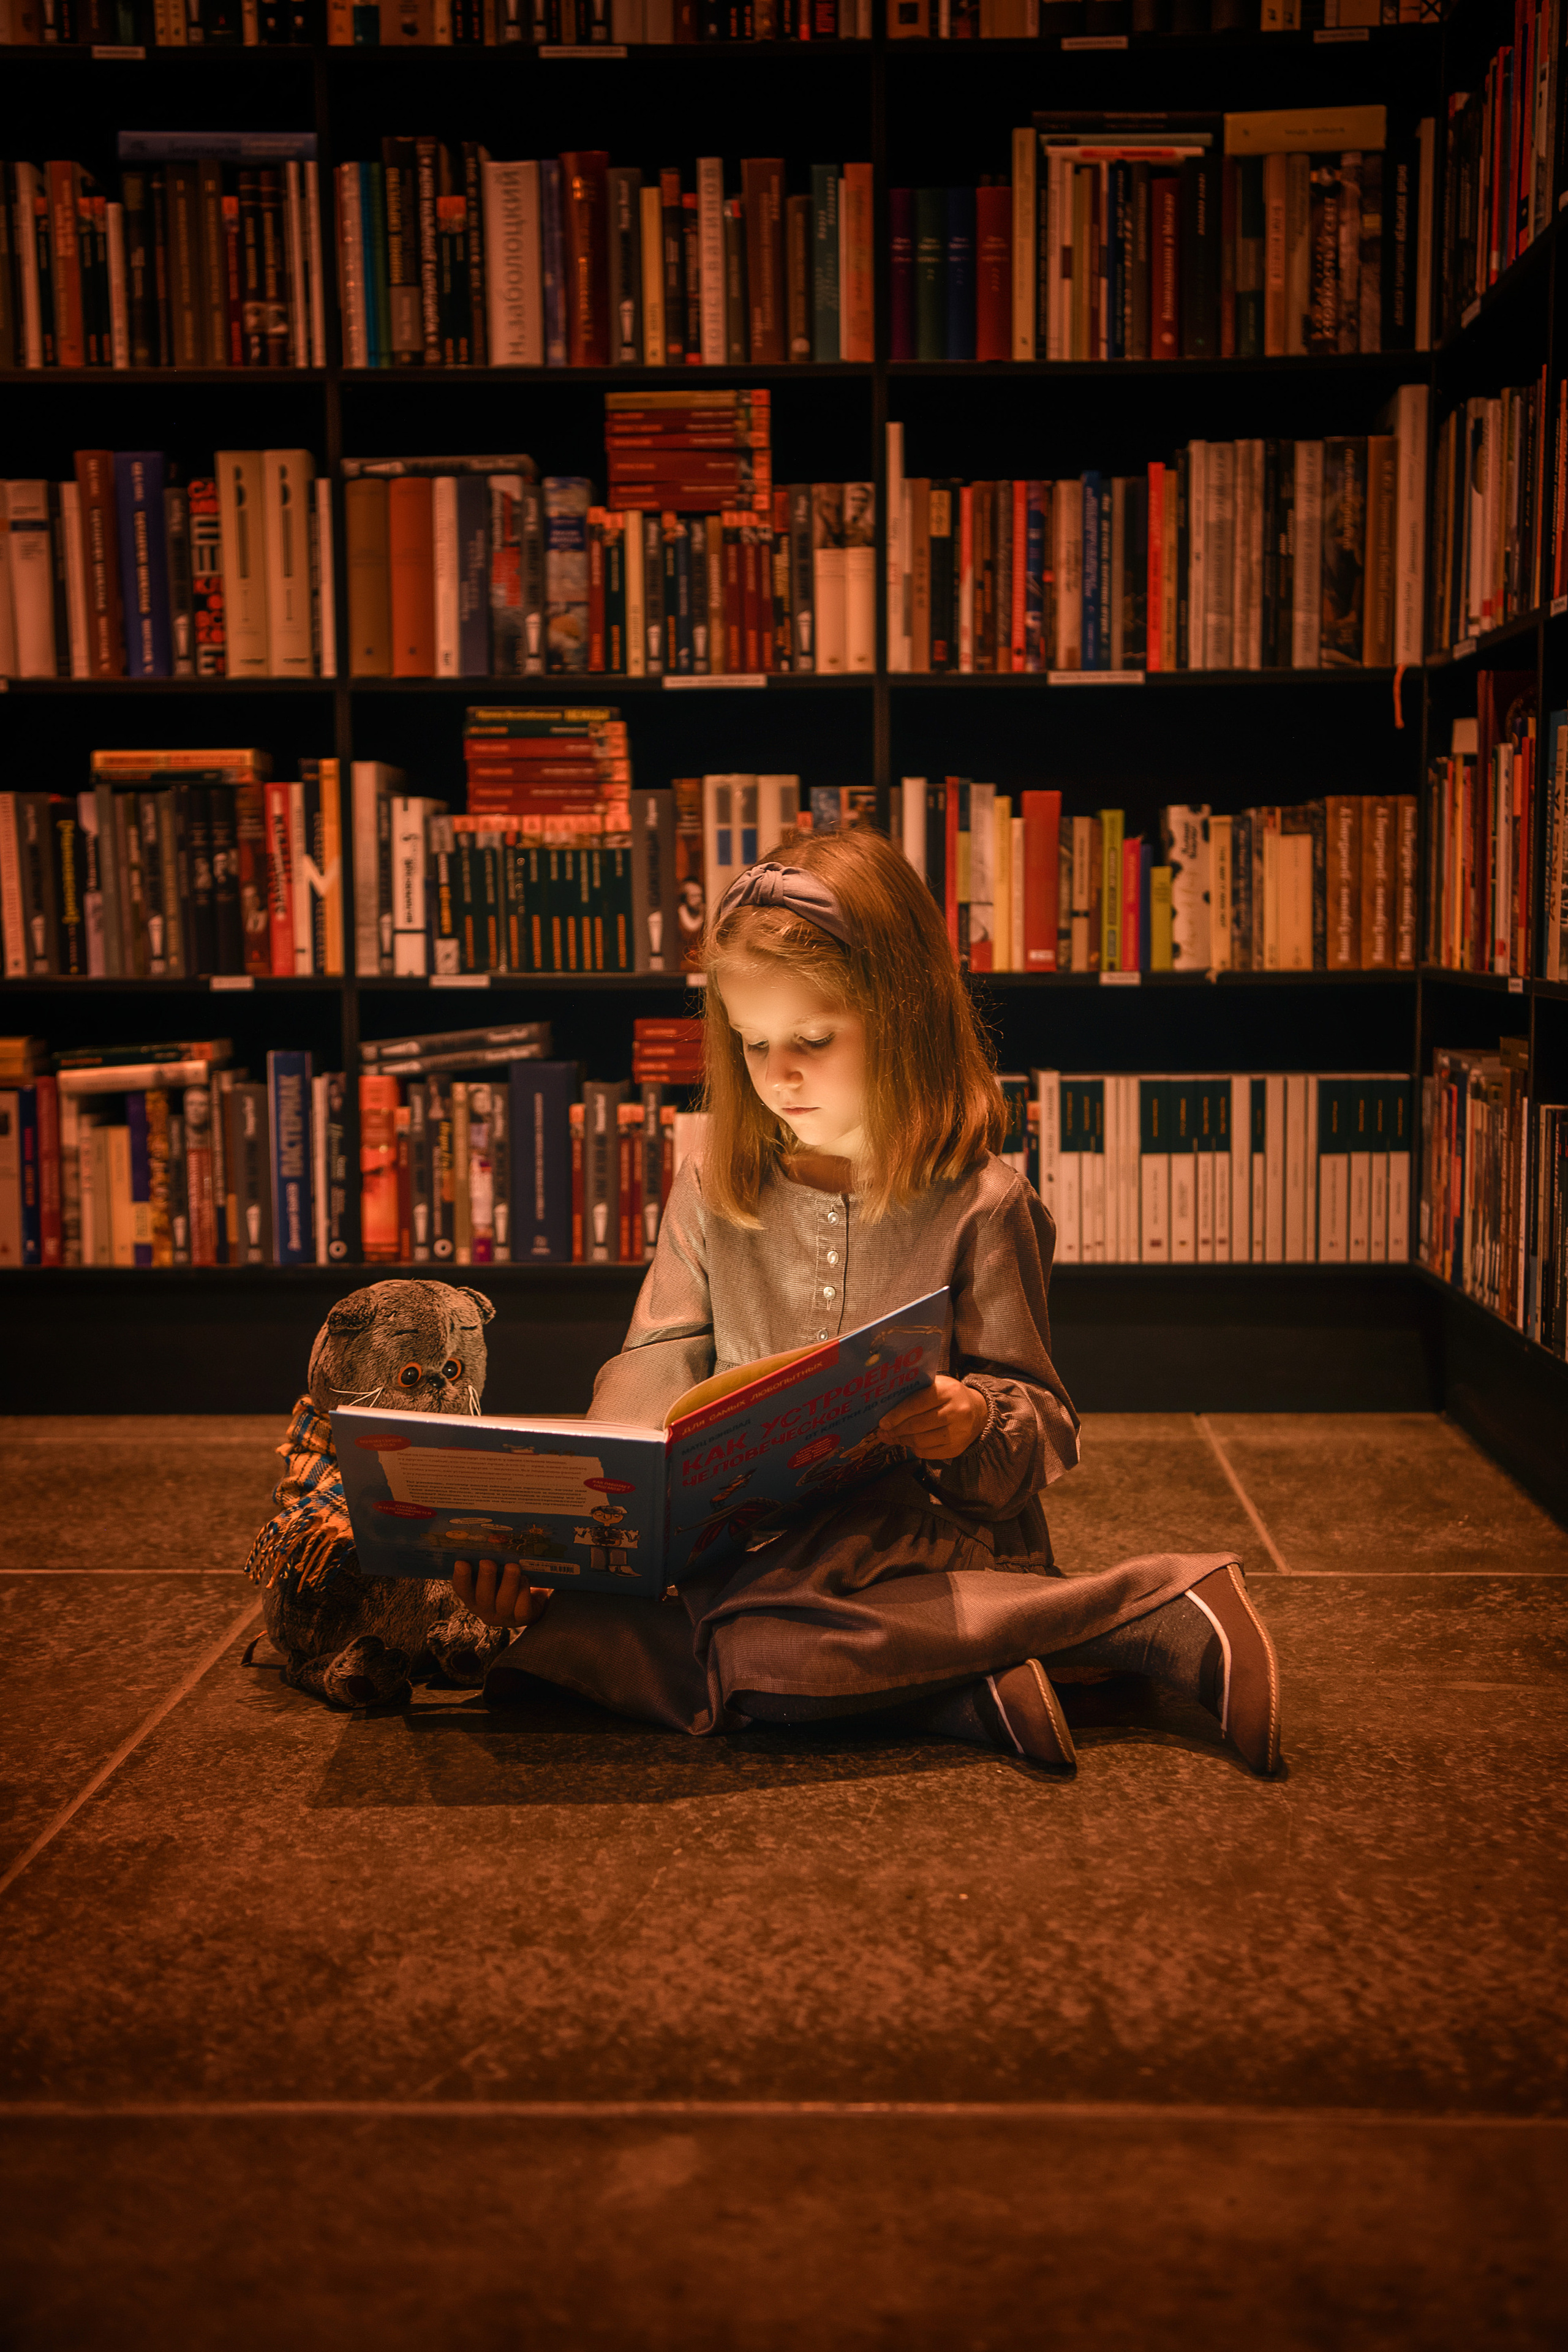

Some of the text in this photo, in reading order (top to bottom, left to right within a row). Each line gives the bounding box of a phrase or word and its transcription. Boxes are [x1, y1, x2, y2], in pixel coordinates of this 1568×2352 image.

[279, 1074, 304, 1178] ПАСТЕРНАК
[682, 1360, 824, 1436] ДЛЯ САМЫХ ЛЮБОПЫТНЫХ
[682, 1432, 748, 1477] КАК
[761, 1346, 924, 1441] УСТРОЕНО
[682, 1399, 852, 1487] ЧЕЛОВЕЧЕСКОЕ
[861, 1368, 919, 1403] ТЕЛО
[805, 1380, 920, 1441] ОТ КЛЕТКИ ДО СЕРДЦА
